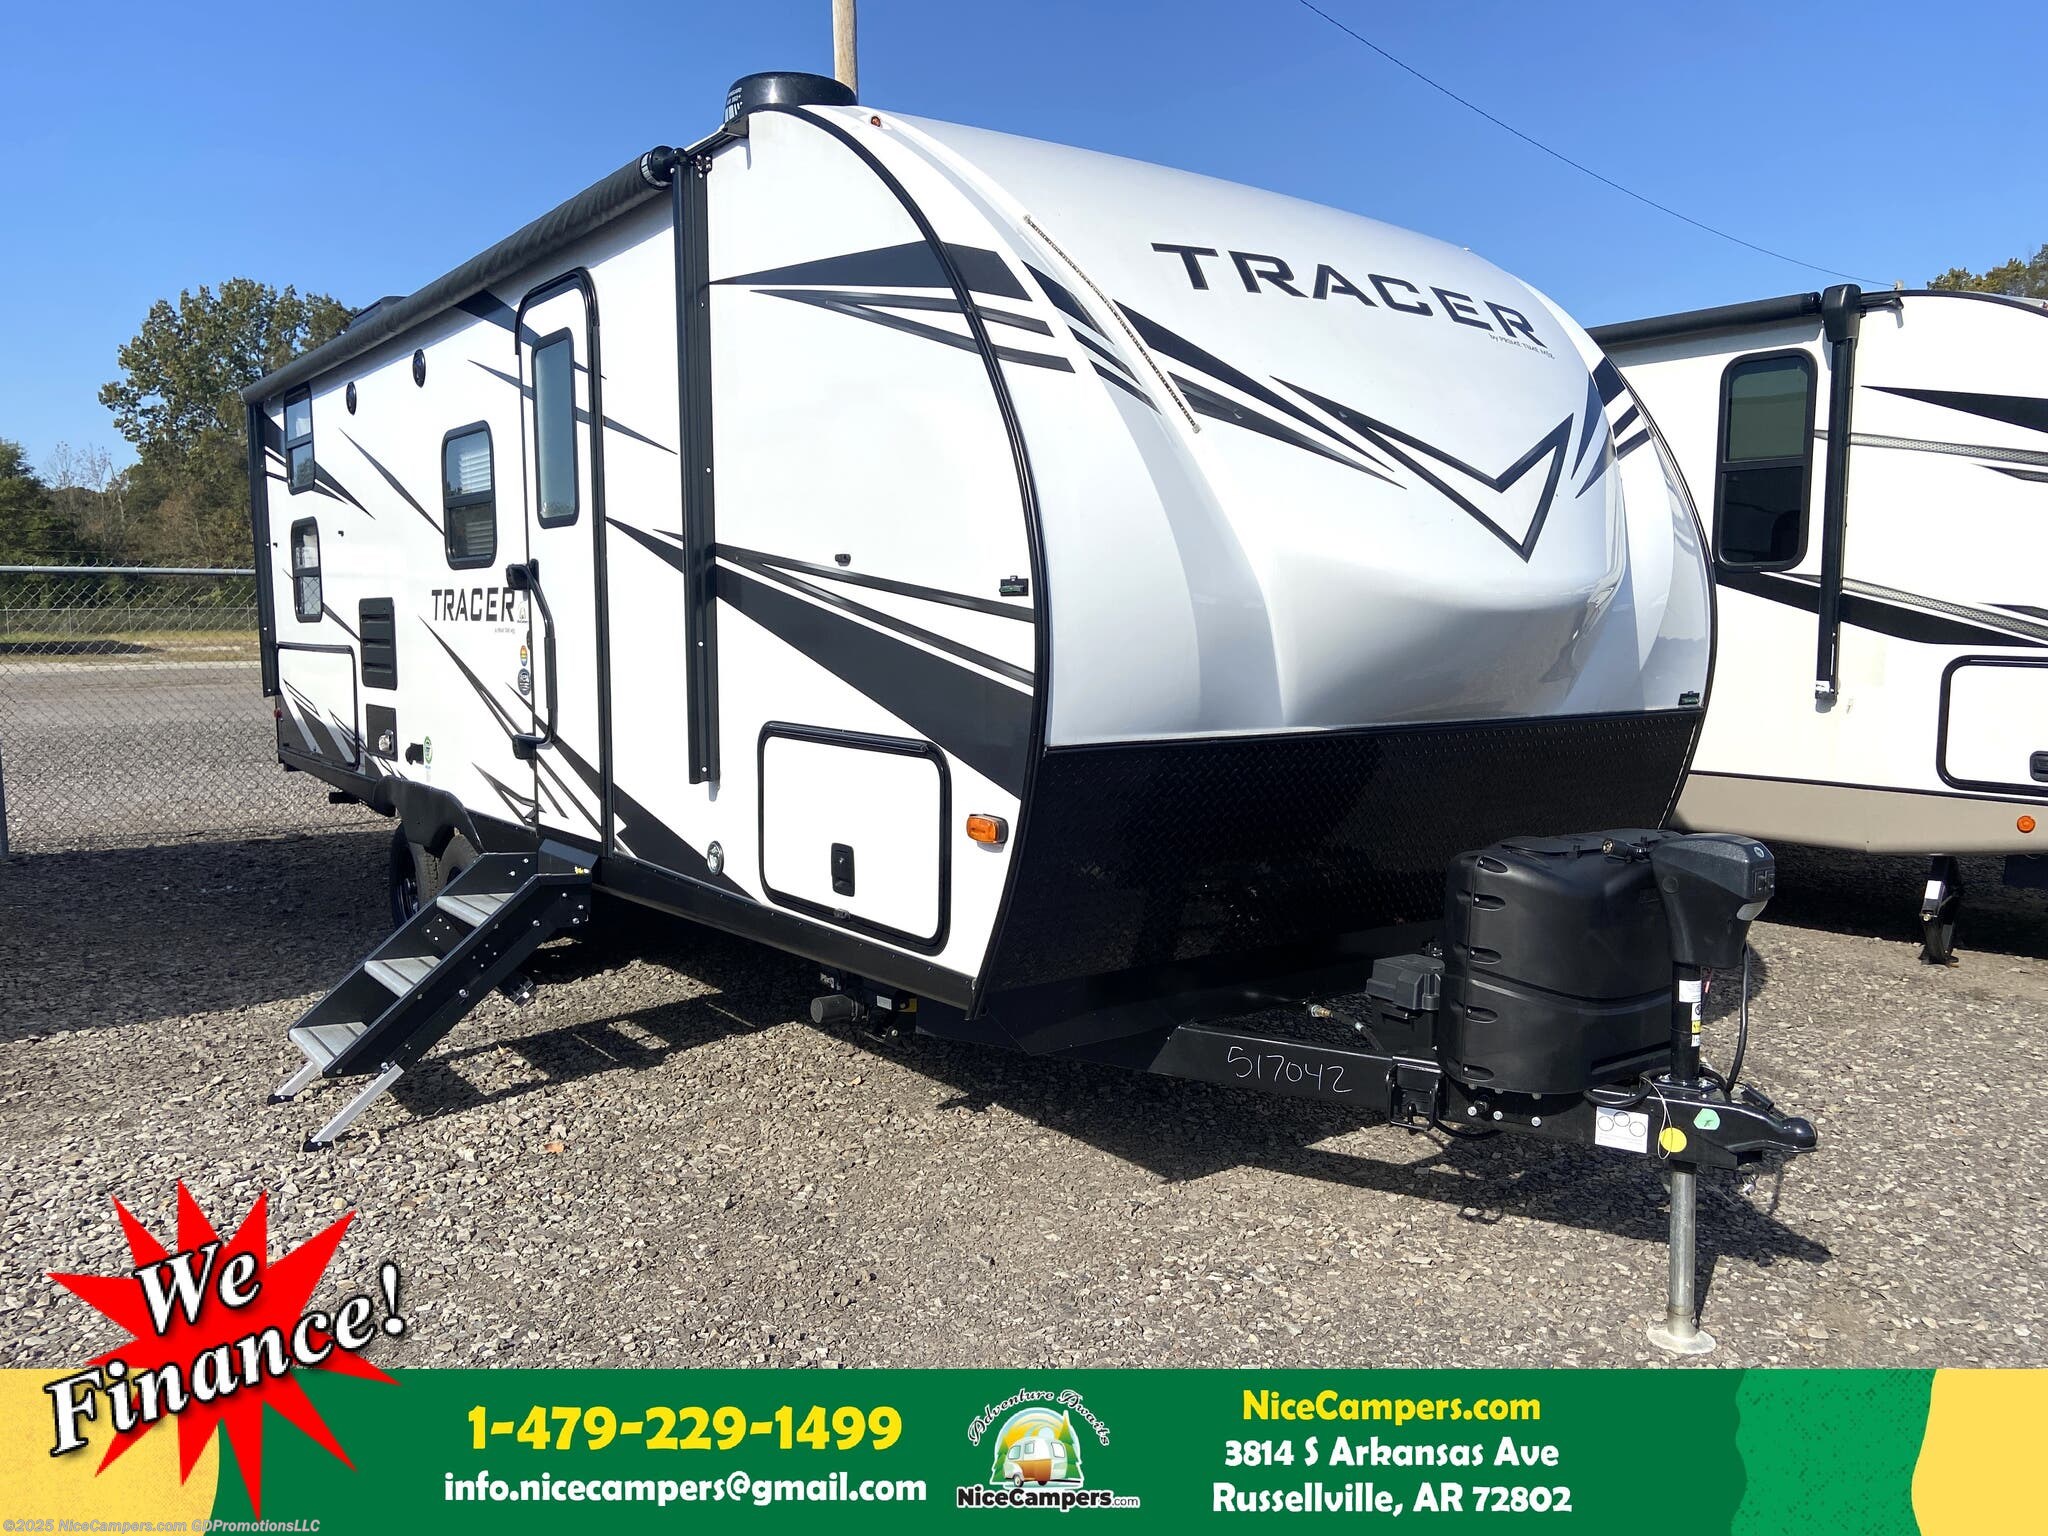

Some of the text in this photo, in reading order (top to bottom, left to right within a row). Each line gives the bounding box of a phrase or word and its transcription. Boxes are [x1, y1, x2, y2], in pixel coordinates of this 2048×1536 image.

[1151, 243, 1547, 348] TRACER
[431, 587, 515, 622] TRACER
[1227, 1046, 1353, 1093] 517042
